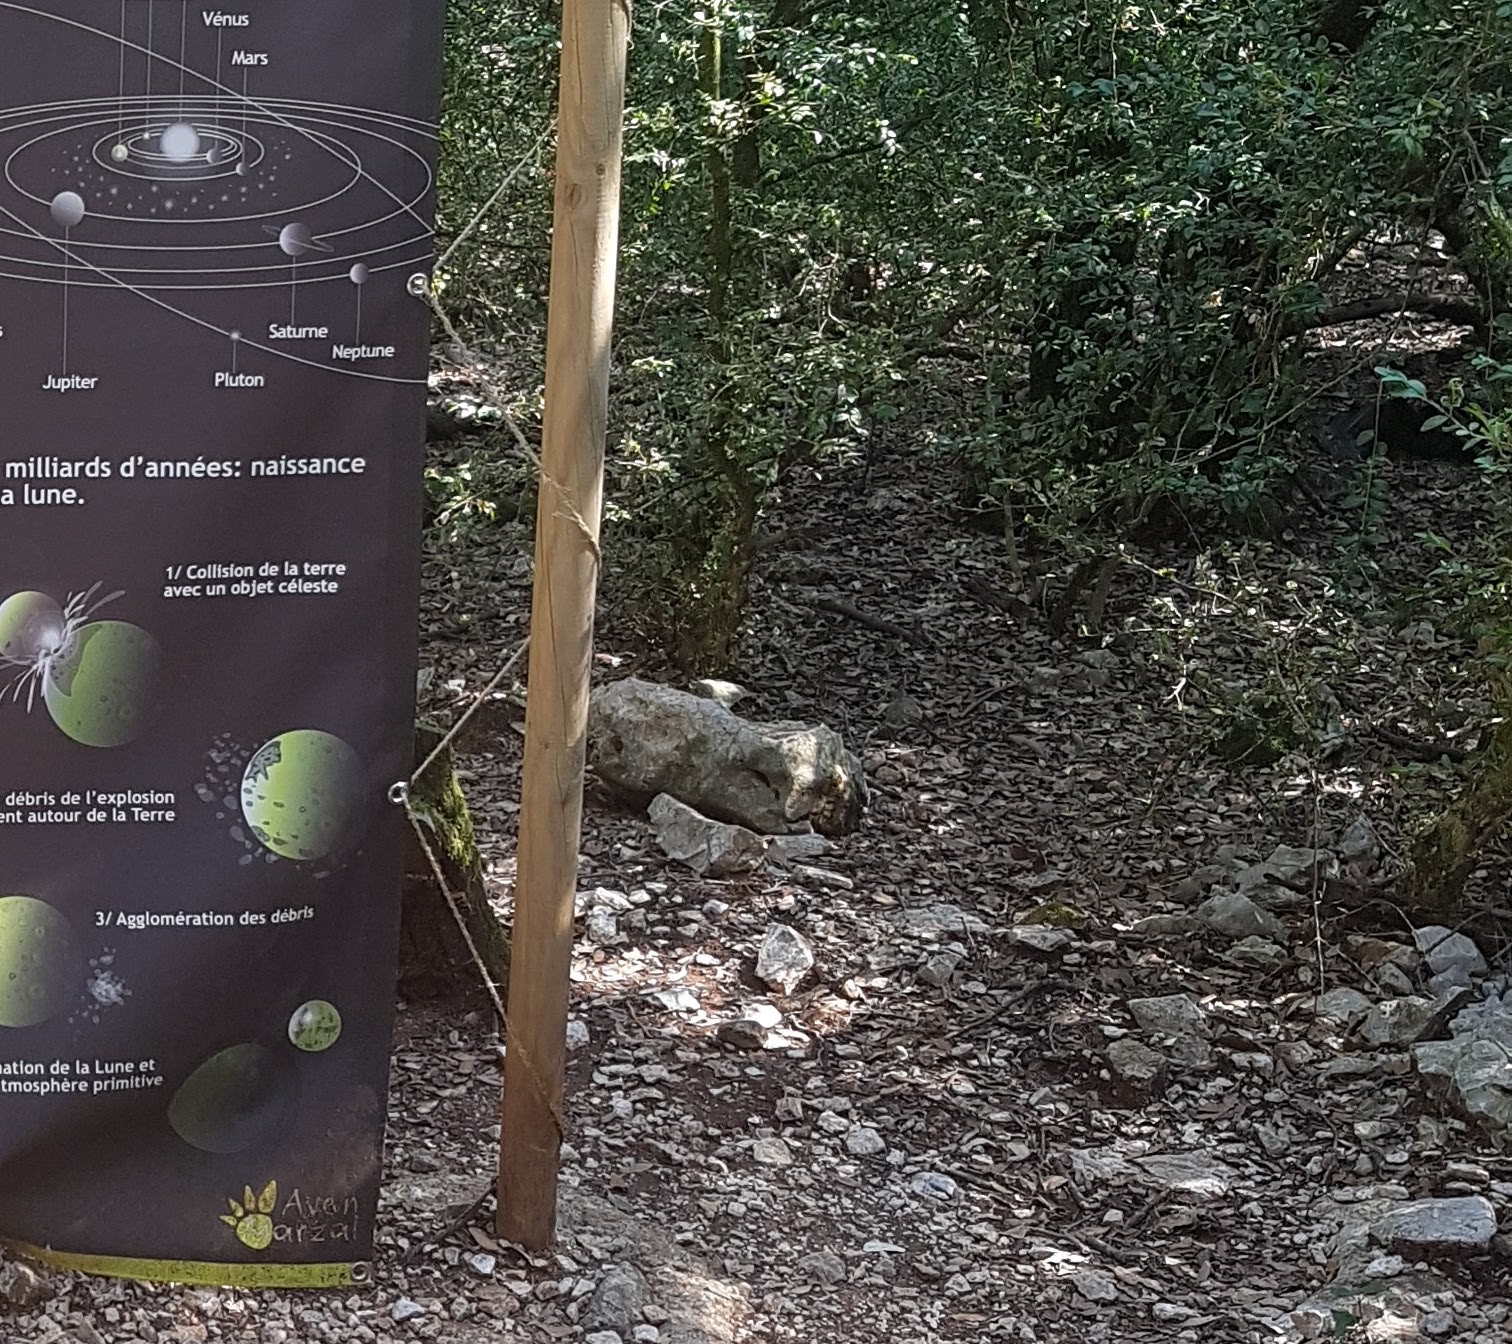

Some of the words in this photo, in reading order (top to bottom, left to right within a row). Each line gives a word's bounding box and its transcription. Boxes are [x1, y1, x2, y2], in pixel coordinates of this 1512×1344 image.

[202, 10, 250, 27] Vénus
[231, 50, 269, 65] Mars
[268, 323, 329, 339] Saturne
[332, 344, 395, 362] Neptune
[42, 374, 99, 393] Jupiter
[214, 371, 265, 387] Pluton
[5, 455, 112, 479] milliards
[119, 455, 241, 478] d'années:
[251, 454, 366, 477] naissance
[23, 483, 85, 505] lune.
[165, 565, 183, 580] 1/
[186, 563, 254, 580] Collision
[258, 561, 280, 577] de
[284, 561, 299, 576] la
[303, 562, 347, 576] terre
[163, 585, 202, 598] avec
[205, 583, 226, 596] un
[230, 579, 275, 598] objet
[278, 578, 339, 594] céleste
[5, 791, 56, 807] débris
[60, 791, 81, 805] de
[86, 789, 175, 808] l'explosion
[27, 809, 82, 823] autour
[86, 807, 107, 822] de
[112, 807, 127, 822] la
[130, 807, 176, 822] Terre
[95, 911, 113, 926] 3/
[116, 910, 234, 930] Agglomération
[238, 910, 267, 925] des
[270, 905, 314, 924] débris
[49, 1059, 71, 1075] de
[75, 1059, 90, 1075] la
[95, 1059, 135, 1075] Lune
[138, 1058, 156, 1072] et
[93, 1074, 163, 1095] primitive
